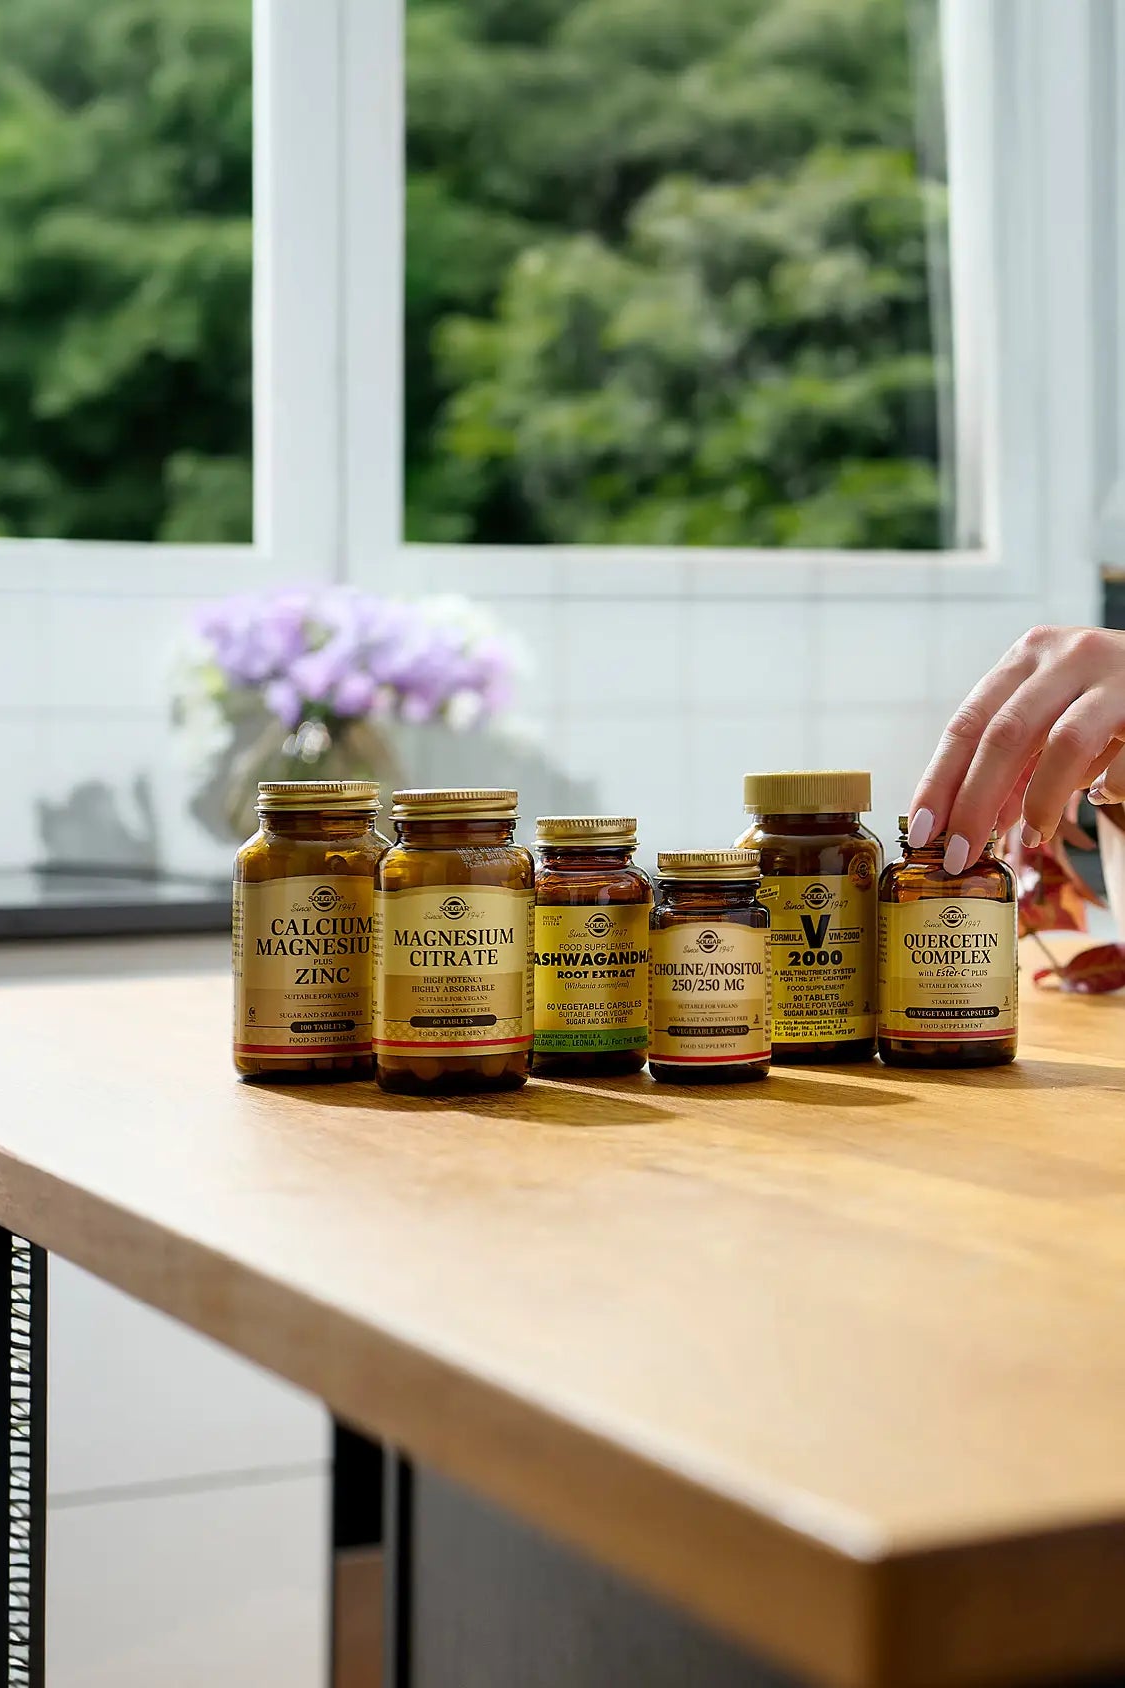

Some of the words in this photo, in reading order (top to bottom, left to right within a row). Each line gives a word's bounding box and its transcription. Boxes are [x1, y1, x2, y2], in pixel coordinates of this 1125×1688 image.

[291, 903, 311, 912] Since
[338, 903, 356, 911] 1947
[784, 901, 805, 910] Since
[831, 900, 848, 909] 1947
[423, 911, 443, 920] Since
[466, 911, 485, 920] 1947
[271, 917, 373, 935] CALCIUM
[924, 920, 942, 928] Since
[964, 920, 981, 928] 1947
[568, 929, 587, 938] Since
[611, 929, 627, 937] 1947
[800, 914, 831, 948] V
[829, 932, 860, 940] VM-2000
[394, 928, 514, 946] MAGNESIUM
[904, 933, 998, 950] QUERCETIN
[255, 937, 371, 955] MAGNESIU
[584, 942, 634, 951] SUPPLEMENT
[683, 945, 698, 953] Since
[719, 945, 734, 953] 1947
[409, 949, 498, 966] CITRATE
[788, 950, 842, 966] 2000
[911, 950, 991, 965] COMPLEX
[592, 969, 635, 978] EXTRACT
[655, 963, 763, 977] CHOLINE/INOSITOL
[833, 967, 856, 975] SYSTEM
[919, 969, 934, 977] with
[971, 969, 988, 977] PLUS
[295, 967, 350, 984] ZINC
[423, 976, 443, 984] HIGH
[446, 976, 483, 984] POTENCY
[442, 984, 495, 993] ABSORBABLE
[565, 981, 595, 990] (Withania
[672, 979, 719, 993] 250/250
[724, 979, 744, 991] MG
[556, 1002, 605, 1010] VEGETABLE
[607, 1000, 642, 1009] CAPSULES
[960, 1008, 995, 1017] CAPSULES
[442, 1017, 474, 1025] TABLETS
[313, 1023, 347, 1031] TABLETS
[676, 1027, 715, 1035] VEGETABLE
[440, 1029, 487, 1037] SUPPLEMENT
[310, 1035, 356, 1043] SUPPLEMENT
[534, 1039, 554, 1047] OLGAR,
